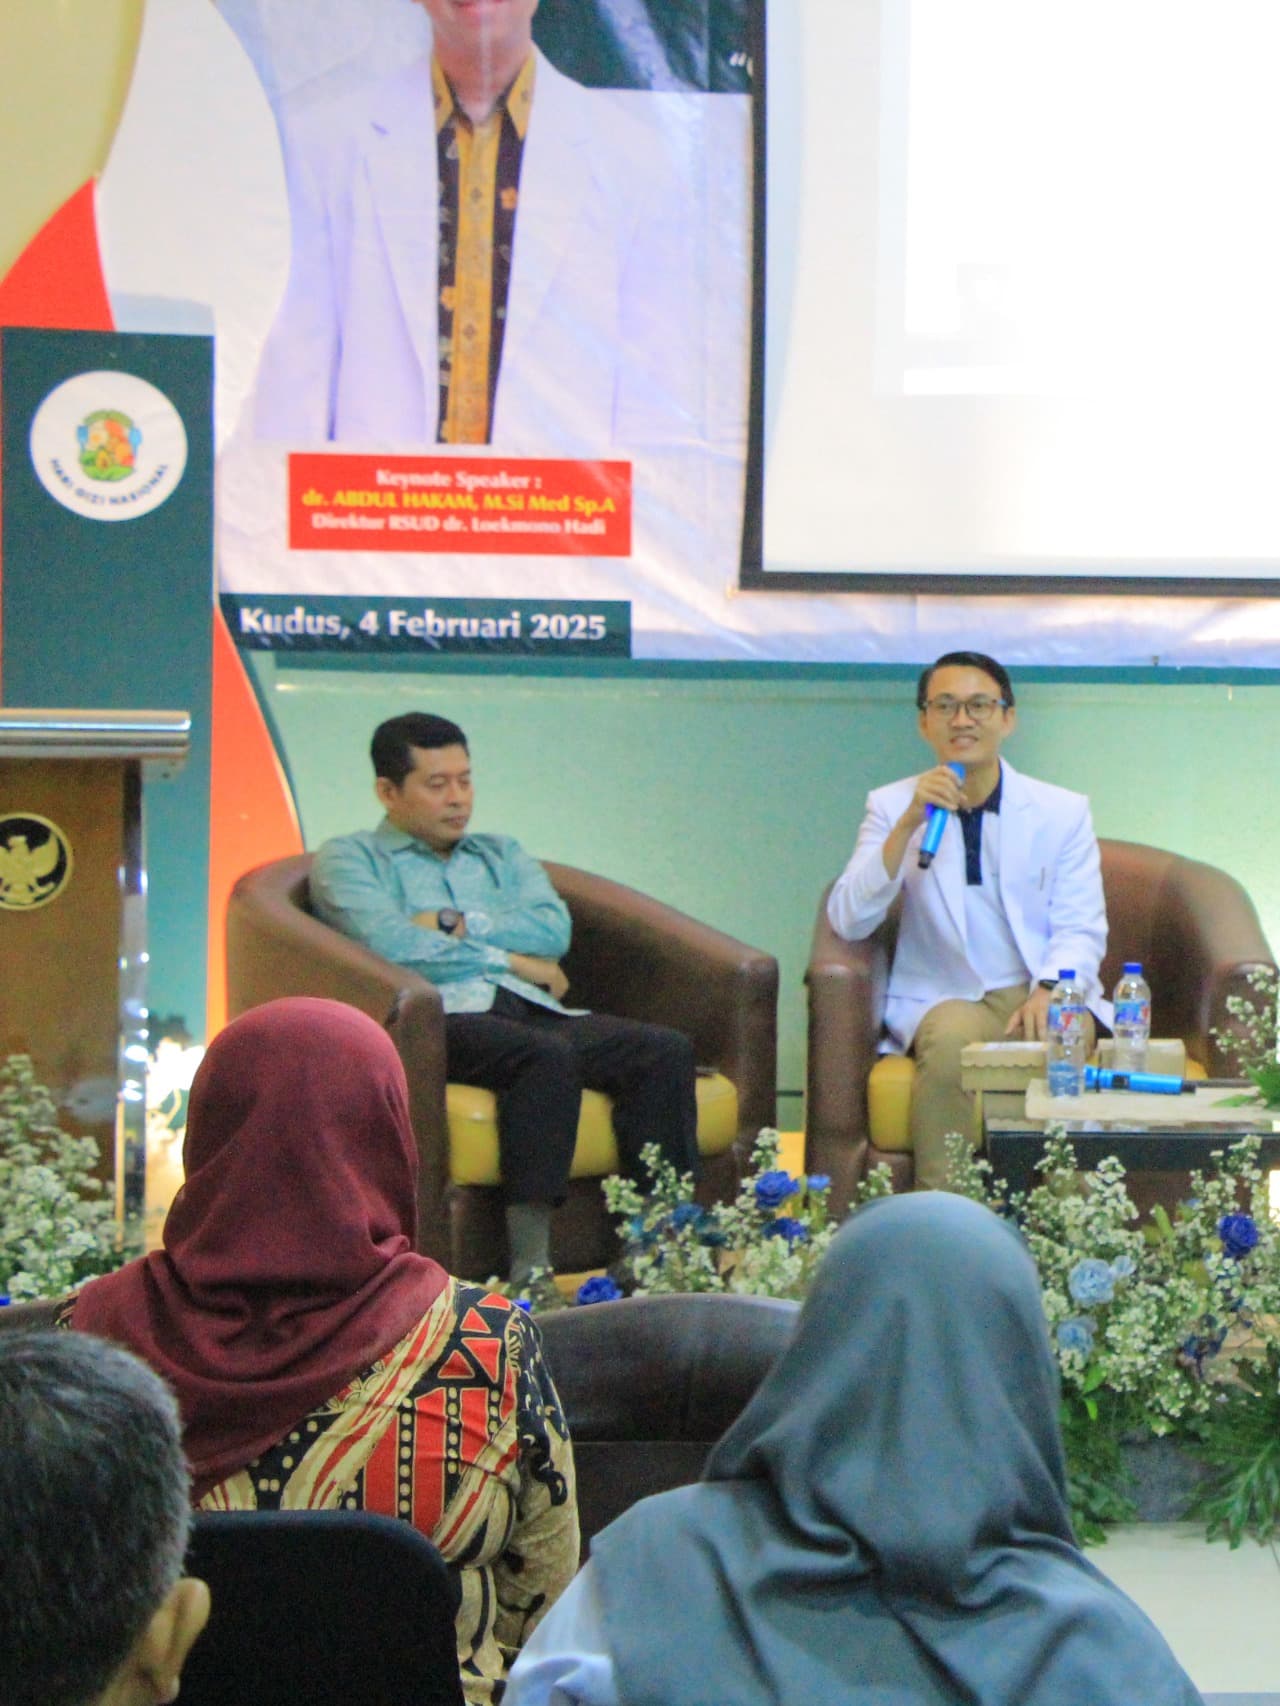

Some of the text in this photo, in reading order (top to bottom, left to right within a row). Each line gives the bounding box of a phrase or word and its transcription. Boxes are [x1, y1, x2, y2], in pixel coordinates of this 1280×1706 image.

[376, 469, 452, 490] Keynote
[456, 471, 530, 492] Speaker
[302, 489, 328, 506] dr.
[333, 490, 397, 508] ABDUL
[402, 491, 479, 511] HAKAM,
[528, 493, 570, 511] Med
[573, 494, 616, 516] Sp.A
[311, 512, 385, 530] Direktur
[389, 513, 440, 531] RSUD
[442, 514, 468, 532] dr.
[564, 517, 606, 535] Hadi
[240, 607, 607, 640] Kudus, 4 Februari 2025
